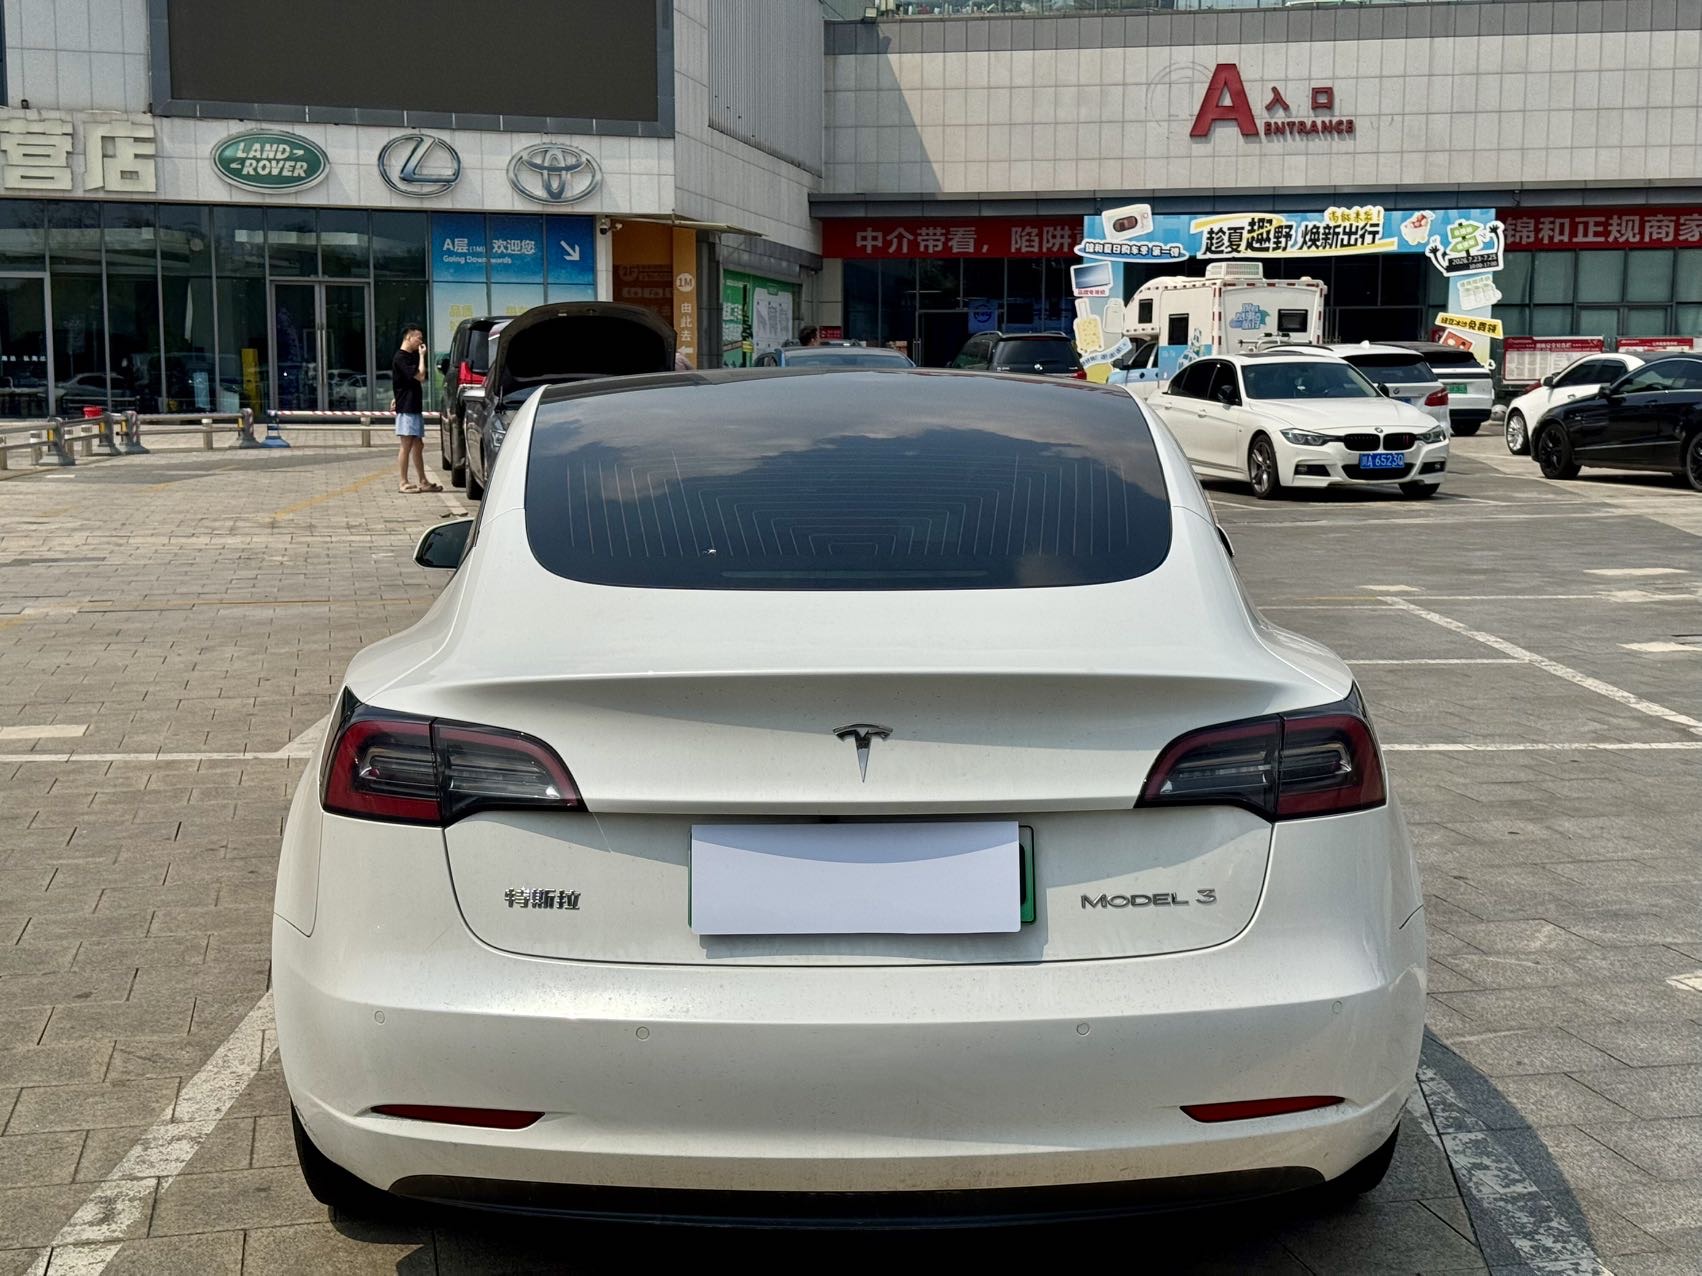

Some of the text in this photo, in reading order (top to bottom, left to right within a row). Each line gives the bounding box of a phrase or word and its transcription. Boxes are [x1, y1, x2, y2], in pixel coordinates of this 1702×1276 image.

[1190, 63, 1259, 136] A
[1265, 86, 1334, 111] 入口
[1264, 120, 1354, 136] ENTRANCE
[236, 142, 290, 159] LAND
[241, 159, 308, 177] ROVER
[856, 226, 1083, 253] 中介带看，陷阱
[1298, 222, 1380, 251] 焕新出行
[1505, 214, 1702, 244] 锦和正规商家
[492, 239, 536, 254] 欢迎您
[443, 254, 466, 264] Going
[677, 277, 693, 288] 1M
[680, 302, 692, 342] 由此去
[504, 888, 581, 910] 特斯拉
[1081, 888, 1218, 909] MODEL 3
